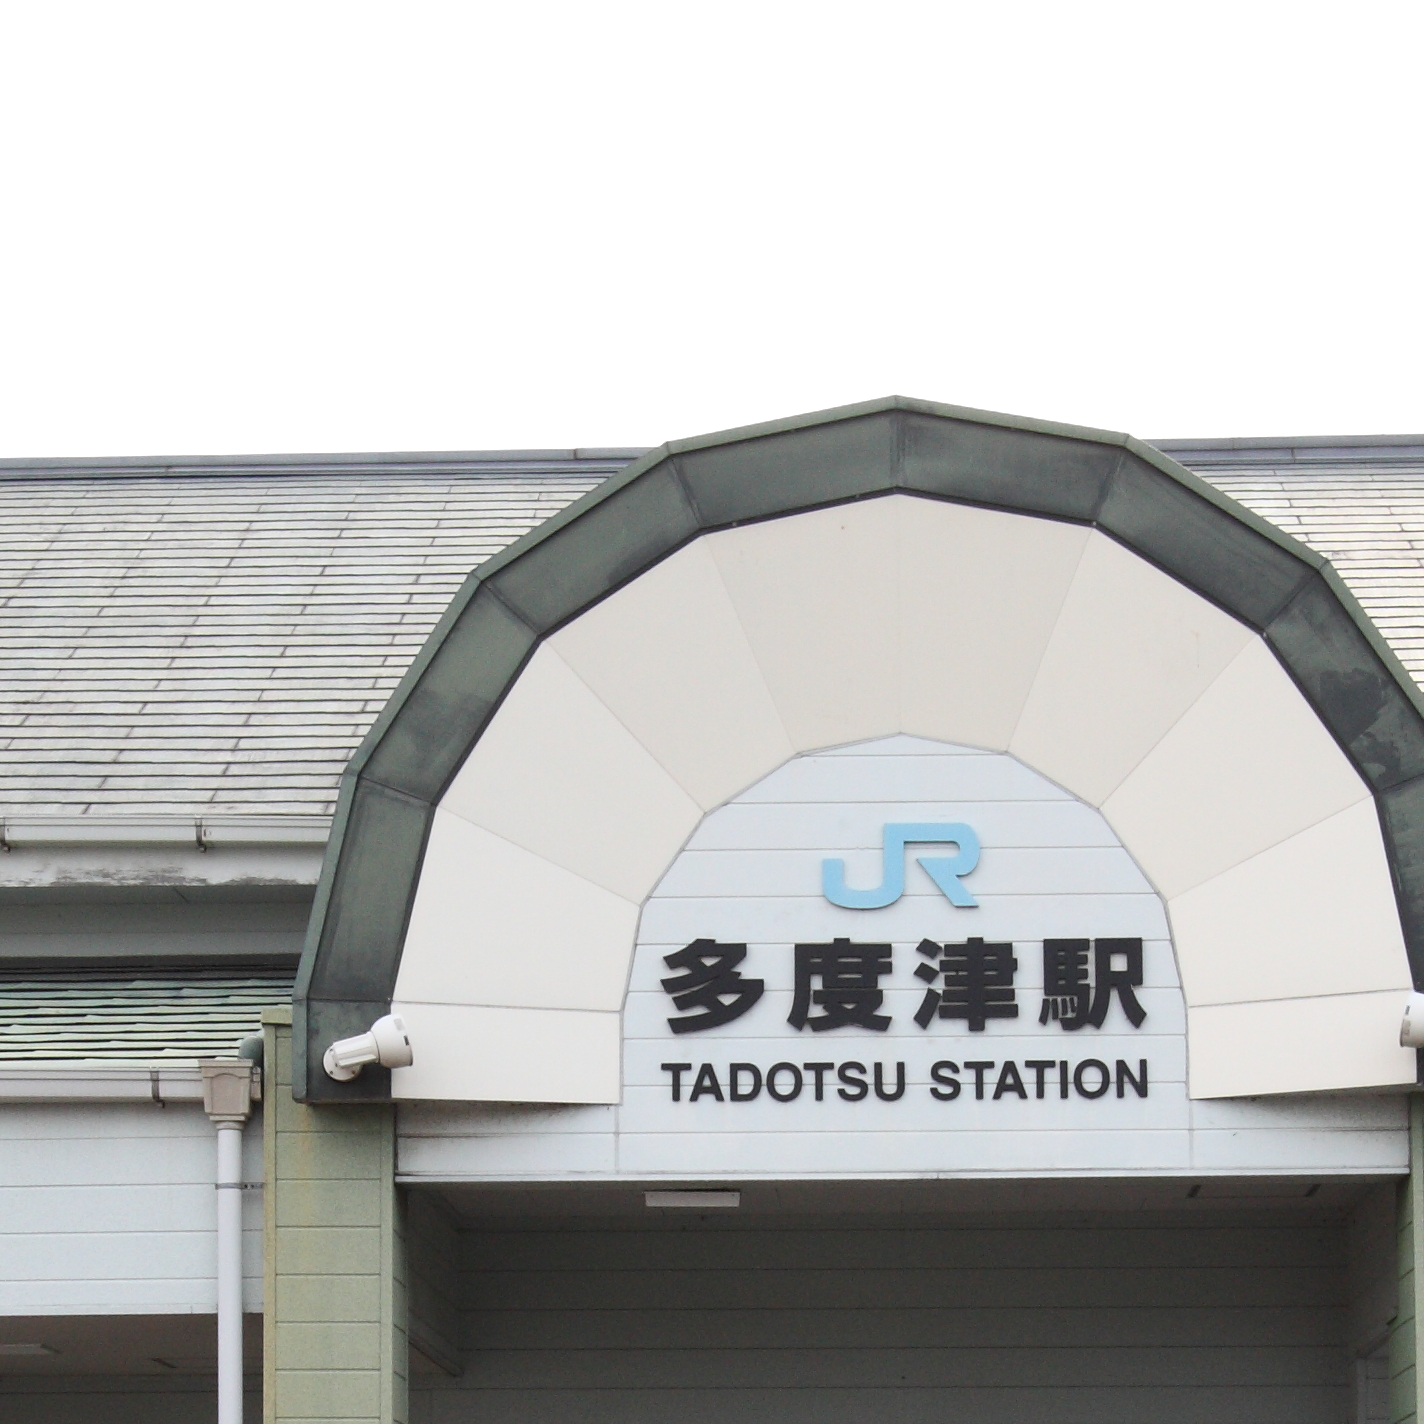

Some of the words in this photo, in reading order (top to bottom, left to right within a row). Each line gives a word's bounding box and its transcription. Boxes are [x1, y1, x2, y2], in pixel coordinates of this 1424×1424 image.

[822, 821, 980, 909] JR
[659, 936, 1147, 1034] 多度津駅
[660, 1061, 907, 1103] TADOTSU
[929, 1058, 1149, 1101] STATION
